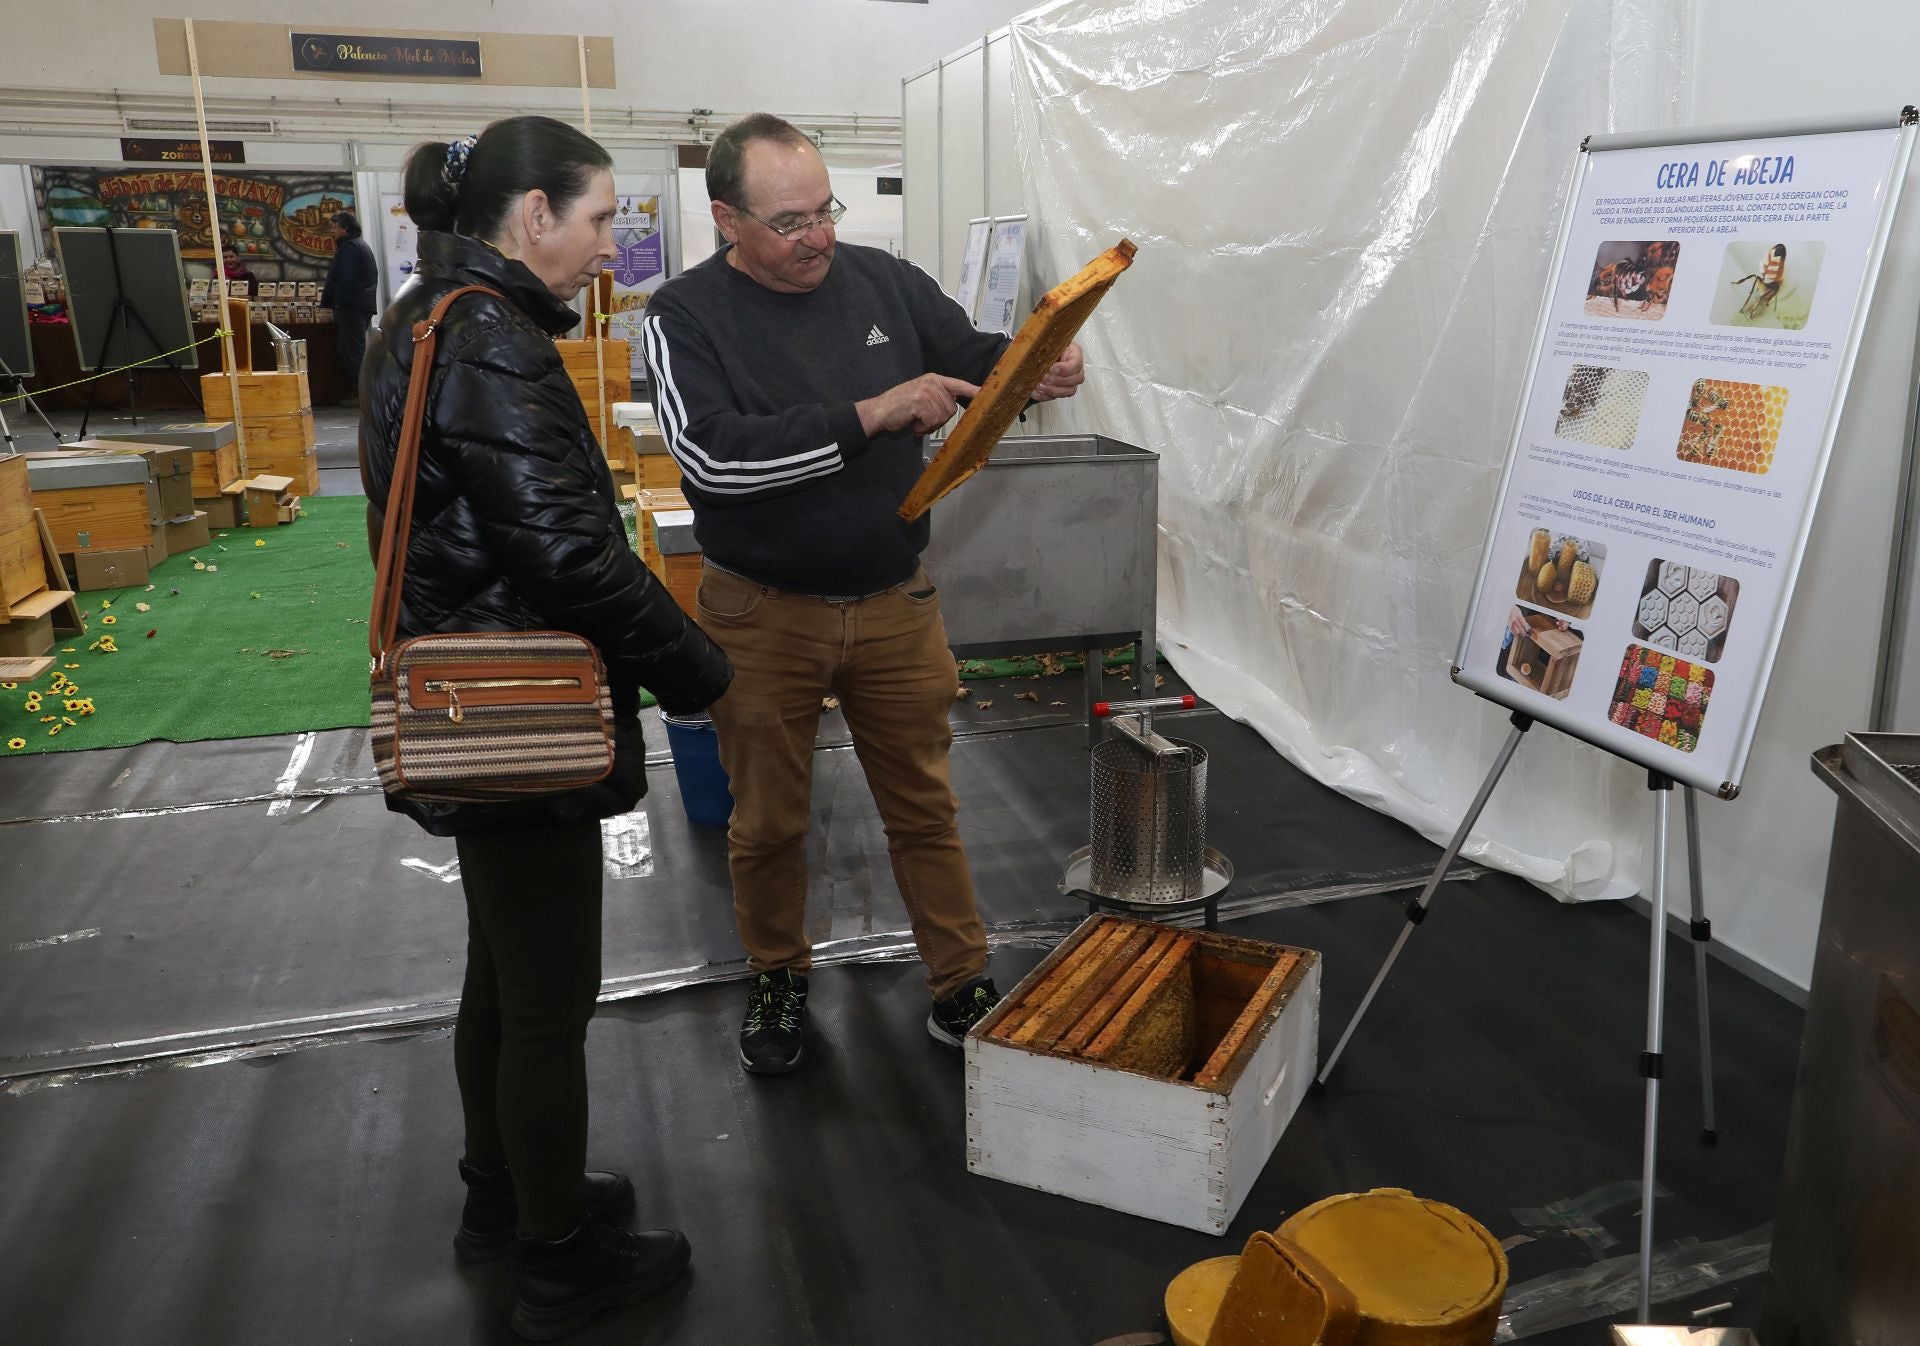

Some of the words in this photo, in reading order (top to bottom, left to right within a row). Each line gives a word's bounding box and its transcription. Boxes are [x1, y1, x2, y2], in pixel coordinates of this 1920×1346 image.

[336, 44, 388, 62] Palencia
[392, 46, 420, 65] Miel
[422, 50, 434, 63] de
[437, 49, 476, 65] Mieles
[176, 143, 214, 151] JABN
[161, 151, 200, 160] ZORRO
[1657, 161, 1699, 189] CERA
[1705, 159, 1729, 187] DE
[1734, 155, 1794, 186] ABEJA
[101, 175, 151, 198] Jabón
[154, 175, 174, 192] de
[175, 172, 226, 194] Zoro
[1602, 197, 1636, 205] PRODUCIDA
[1663, 196, 1686, 204] ABEJAS
[1686, 193, 1722, 203] MELÍFERAS
[1722, 192, 1754, 202] JÓVENES
[1780, 191, 1822, 200] SEGREGAN
[1823, 190, 1848, 198] COMO
[1621, 205, 1644, 214] TRAVÉS
[1665, 204, 1702, 213] GLÁNDULAS
[1746, 203, 1787, 211] CONTACTO
[1683, 214, 1717, 223] PEQUEÑAS
[866, 336, 889, 346] adidas
[1572, 489, 1592, 501] USOS
[1592, 493, 1602, 503] DE
[1603, 496, 1612, 506] LA
[1614, 498, 1634, 510] CERA
[1634, 502, 1651, 514] POR
[1652, 506, 1660, 516] EL
[1662, 508, 1678, 520] SER
[1678, 512, 1716, 528] HUMANO
